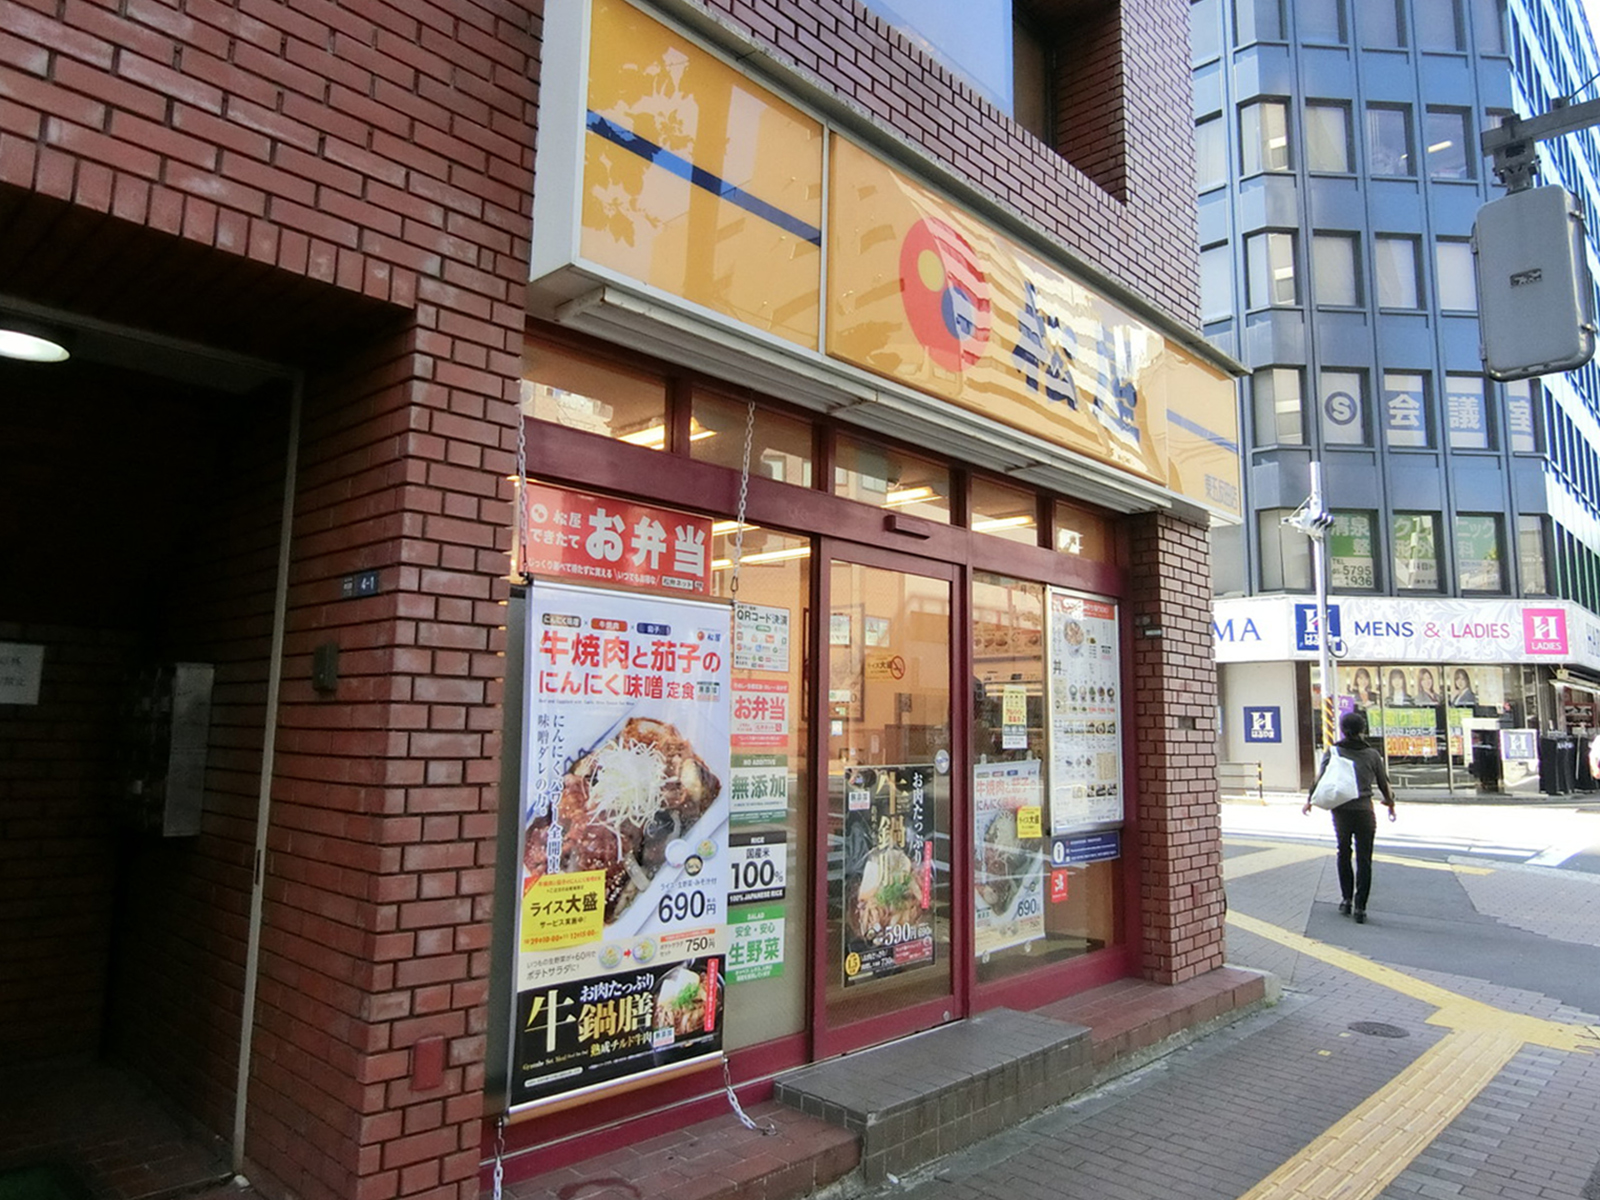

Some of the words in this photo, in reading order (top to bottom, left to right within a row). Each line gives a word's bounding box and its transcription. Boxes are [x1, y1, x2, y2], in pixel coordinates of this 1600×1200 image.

[553, 510, 582, 528] 松屋
[530, 528, 581, 549] できたて
[585, 507, 706, 577] お弁当
[1354, 621, 1414, 638] MENS
[1424, 622, 1441, 638] &
[1451, 622, 1510, 639] LADIES
[539, 630, 721, 673] 牛焼肉と茄子の
[1531, 641, 1562, 651] LADIES
[734, 695, 786, 721] お弁当
[731, 774, 786, 800] 無添加
[912, 771, 924, 867] お肉たっぷり
[750, 836, 765, 844] RICE
[746, 848, 770, 859] 国産米
[731, 860, 783, 889] 100%
[530, 891, 598, 917] ライス大盛
[747, 911, 765, 921] SALAD
[735, 922, 776, 938] 安全・安心
[728, 937, 780, 967] 生野菜
[580, 973, 655, 1002] お肉たっぷり
[524, 989, 654, 1053] 牛鍋膳
